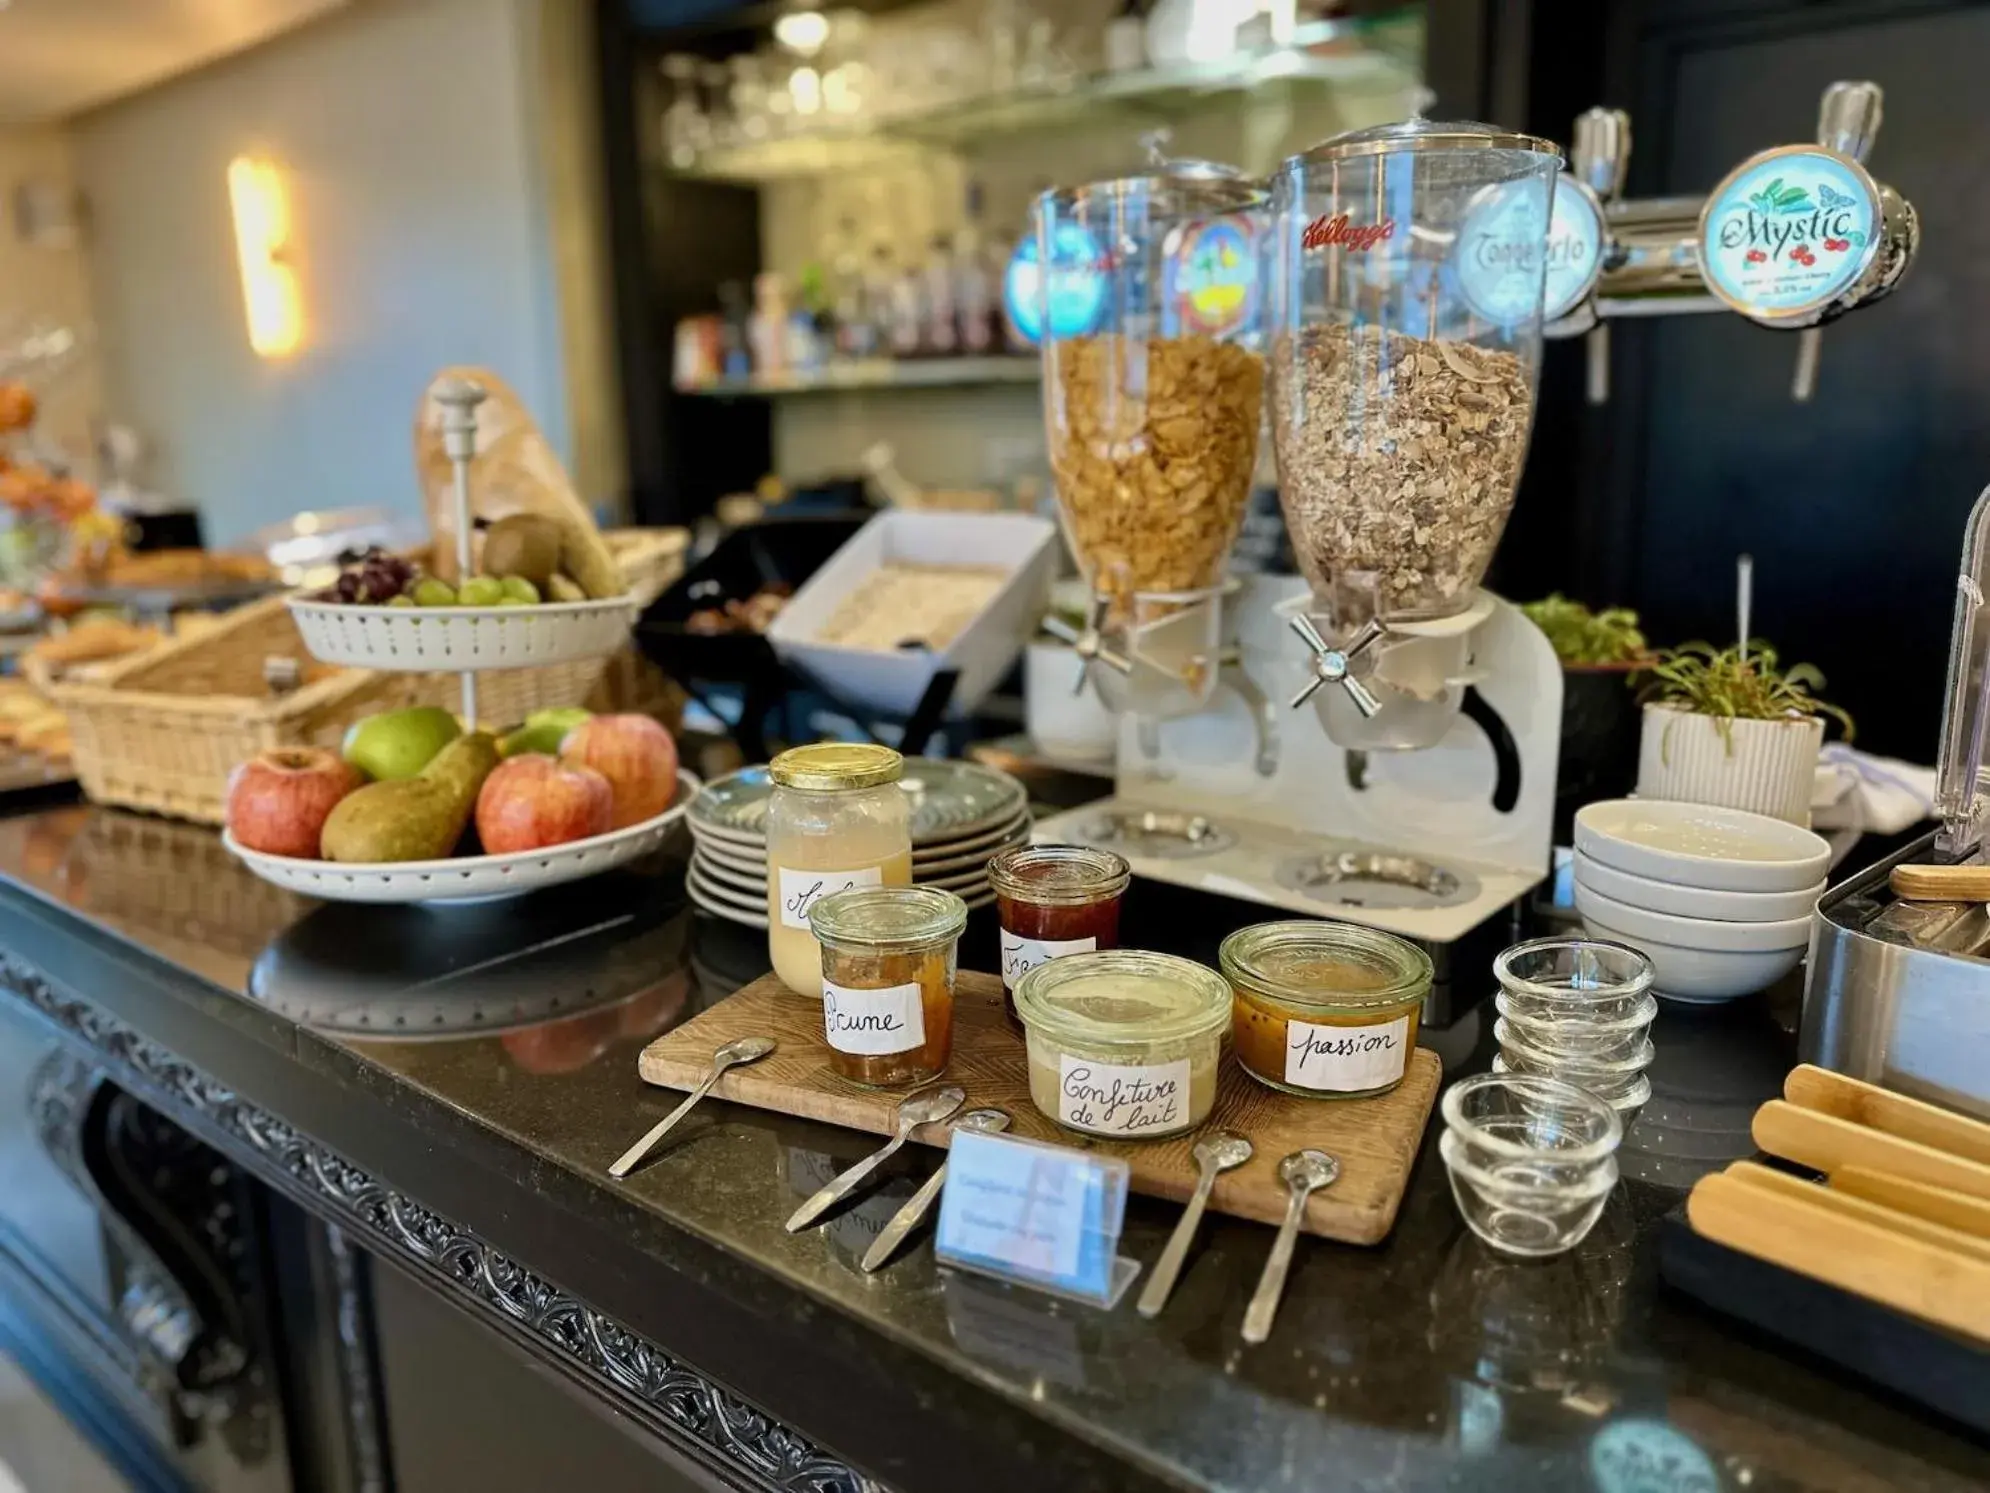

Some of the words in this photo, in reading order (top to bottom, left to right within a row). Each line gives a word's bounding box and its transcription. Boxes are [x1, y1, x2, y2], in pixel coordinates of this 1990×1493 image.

[1720, 208, 1851, 261] Mystic
[825, 991, 904, 1032] Prune
[1291, 1029, 1397, 1069] passion
[1063, 1068, 1177, 1121] Confiture
[1071, 1104, 1097, 1127] de
[1117, 1100, 1178, 1130] lait
